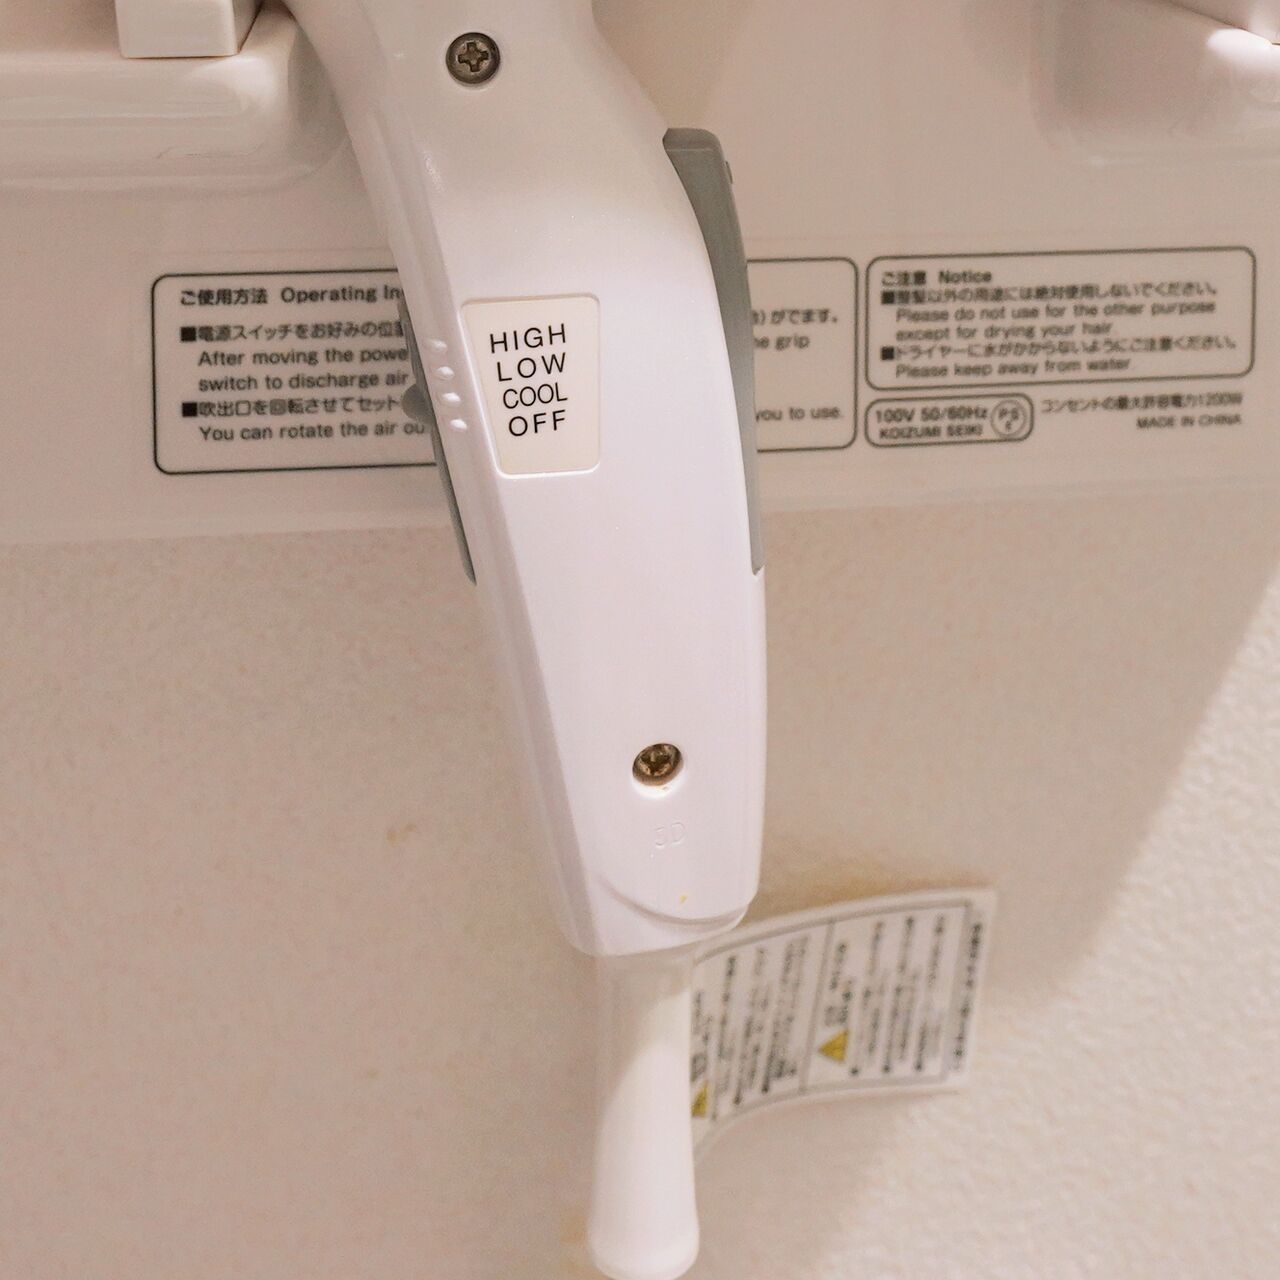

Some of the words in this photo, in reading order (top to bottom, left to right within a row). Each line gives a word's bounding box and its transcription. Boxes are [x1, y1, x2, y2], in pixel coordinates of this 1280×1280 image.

[938, 270, 992, 284] Notice
[180, 287, 268, 306] ご使用方法
[281, 285, 378, 305] Operating
[384, 285, 404, 300] In
[896, 307, 949, 322] Please
[954, 307, 975, 321] do
[980, 306, 1005, 320] not
[1011, 306, 1039, 319] use
[1045, 304, 1066, 318] for
[1073, 304, 1098, 317] the
[1103, 303, 1144, 316] other
[490, 323, 566, 353] HIGH
[896, 327, 950, 341] except
[956, 325, 977, 338] for
[984, 324, 1035, 339] drying
[1040, 324, 1075, 338] your
[1082, 322, 1113, 334] hair
[775, 334, 810, 351] grip
[198, 350, 245, 367] After
[252, 349, 318, 366] moving
[325, 347, 354, 362] the
[360, 347, 409, 363] powe
[497, 352, 566, 382] LOW
[896, 364, 948, 378] Please
[954, 363, 993, 376] keep
[997, 363, 1038, 378] away
[1044, 360, 1081, 373] from
[1086, 358, 1131, 371] water
[198, 376, 258, 392] switch
[265, 375, 282, 390] to
[288, 373, 380, 390] discharge
[385, 372, 409, 386] air
[503, 382, 568, 409] COOL
[509, 409, 566, 437] OFF
[789, 407, 806, 420] to
[876, 407, 915, 423] 100V
[1136, 416, 1174, 429] MADE
[1181, 415, 1195, 427] IN
[1198, 414, 1242, 427] CHINA
[199, 426, 234, 441] You
[240, 426, 273, 440] can
[279, 423, 334, 439] rotate
[340, 422, 369, 437] the
[374, 422, 396, 435] air
[879, 426, 942, 439] KOIZUMI
